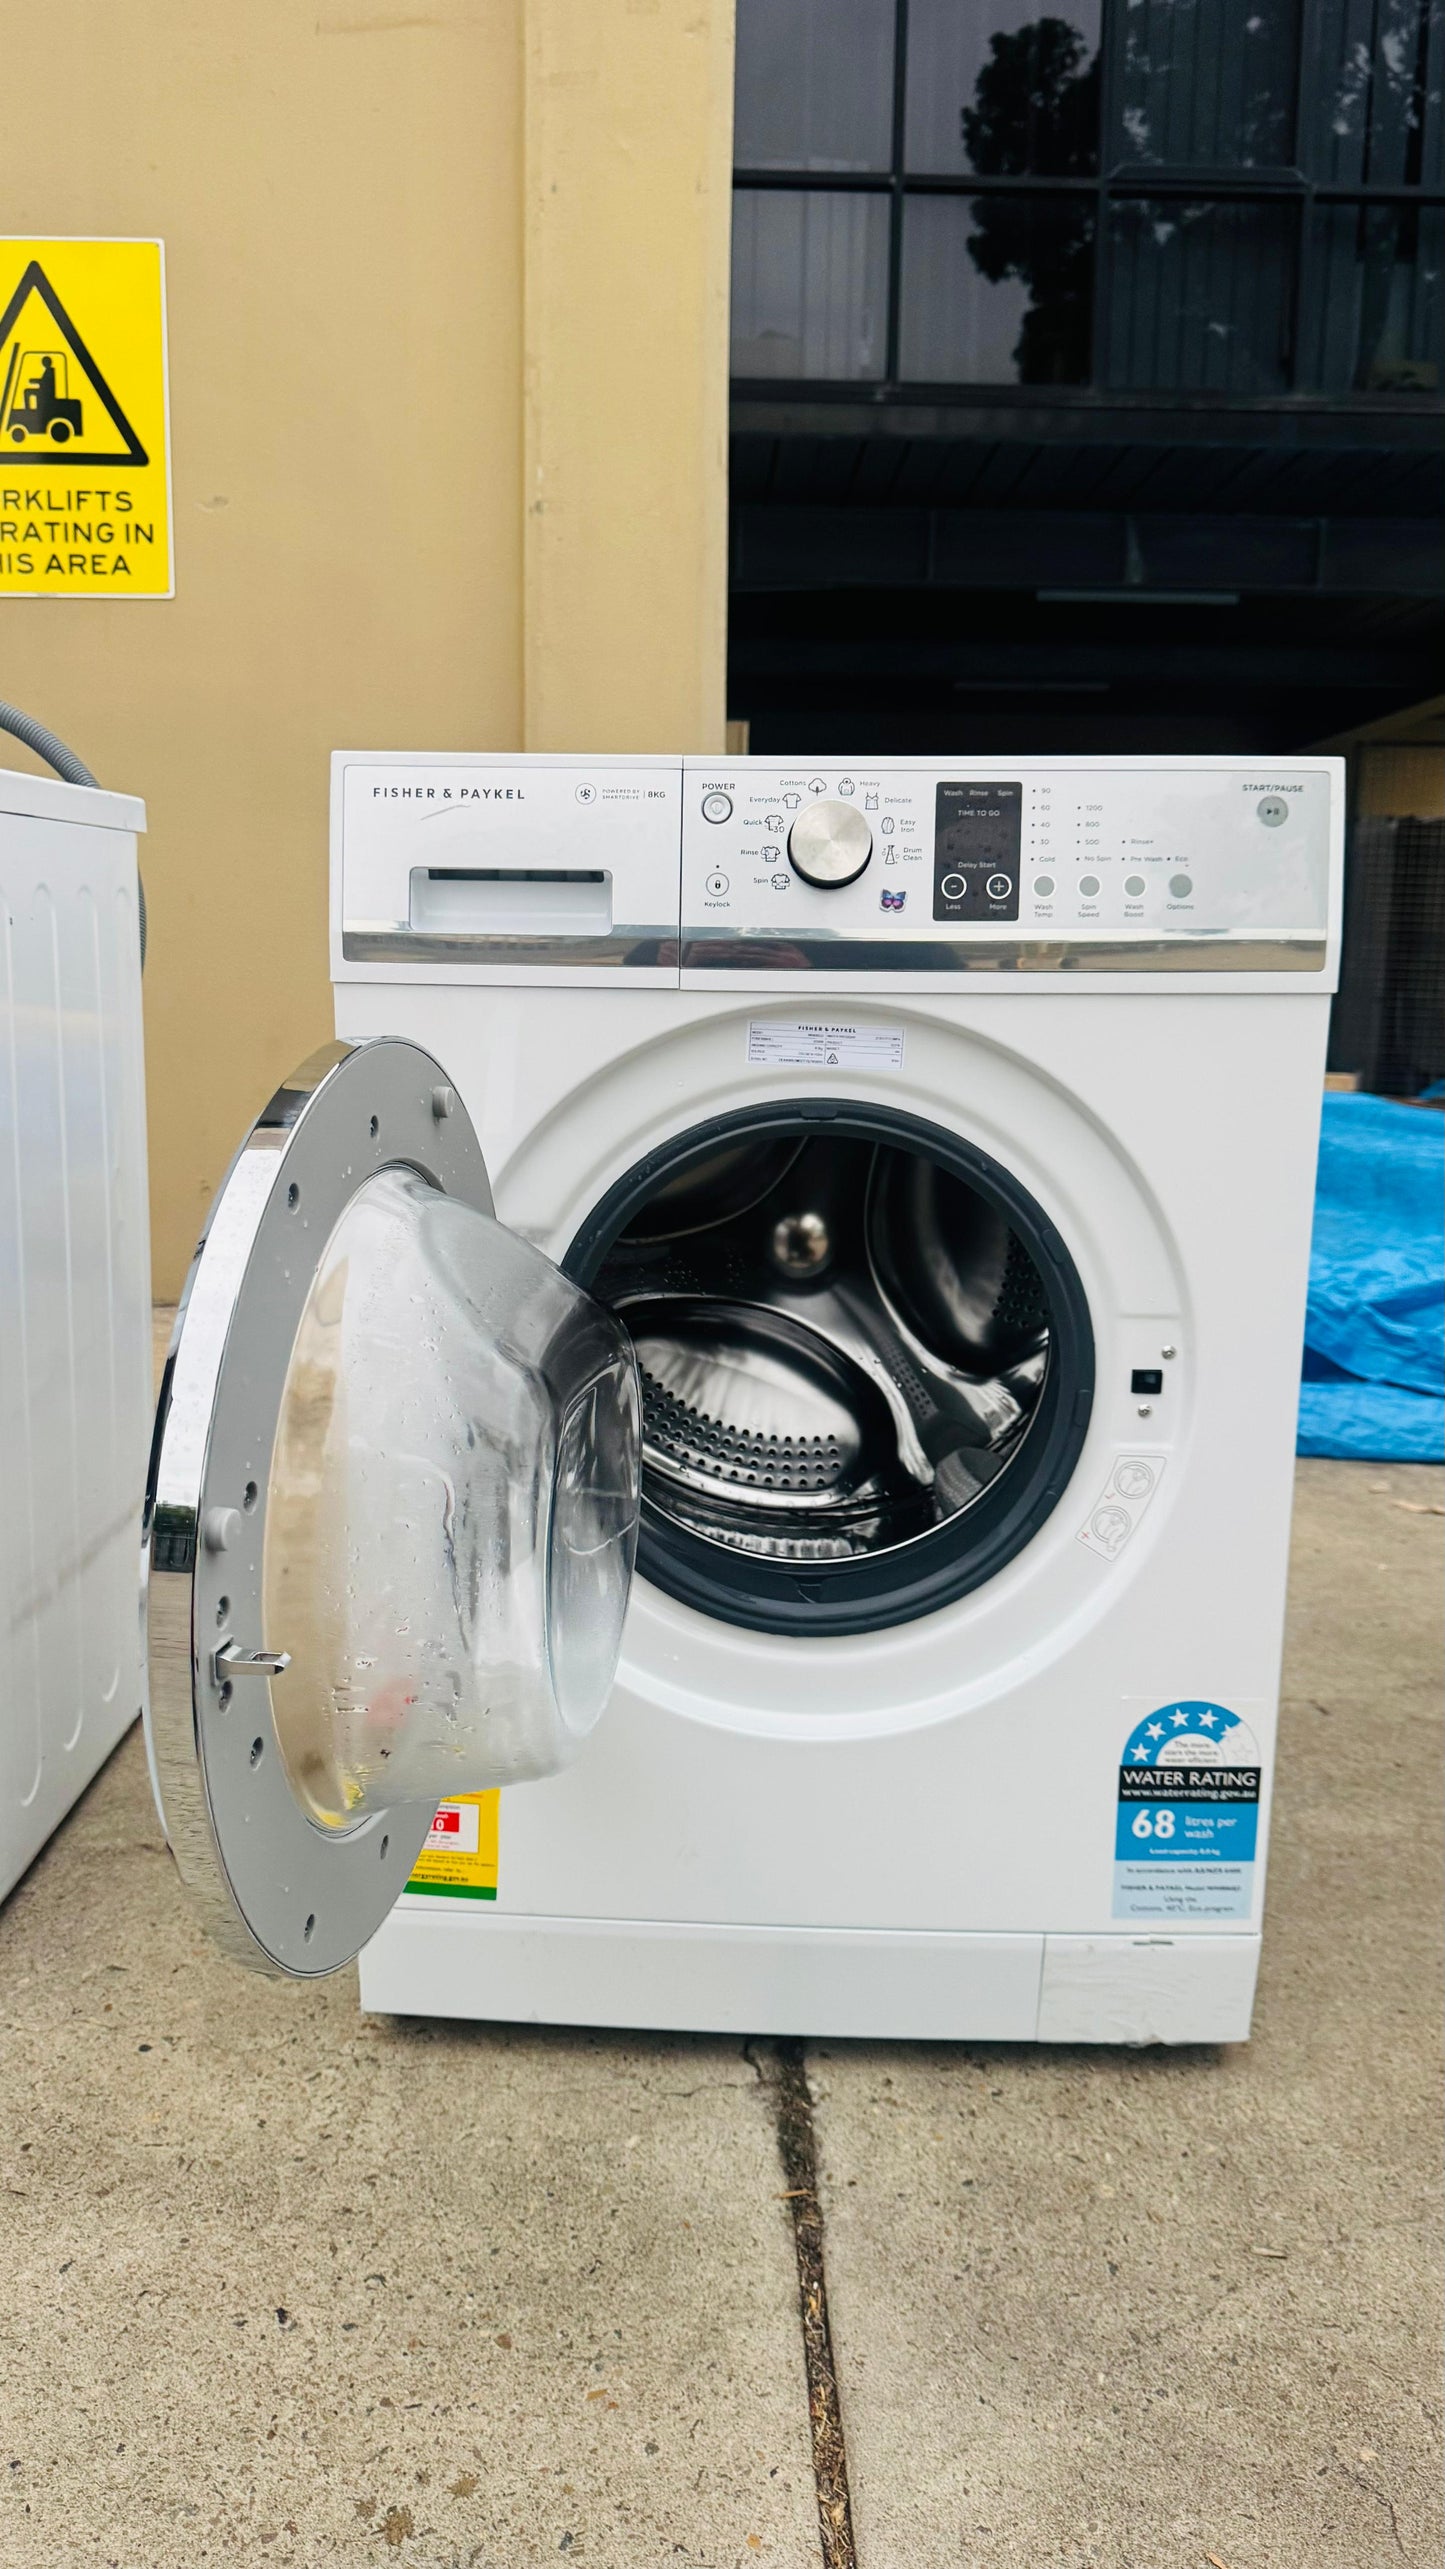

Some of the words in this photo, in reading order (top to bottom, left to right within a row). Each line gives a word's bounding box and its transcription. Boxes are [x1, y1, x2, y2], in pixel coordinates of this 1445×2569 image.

[126, 523, 154, 544] IN
[0, 553, 34, 575] IS
[45, 554, 131, 575] AREA
[779, 779, 807, 787] Cottons
[859, 780, 881, 788] Heavy
[1242, 784, 1304, 793] START/PAUSE
[373, 787, 436, 799] FISHER
[443, 788, 453, 799] &
[461, 788, 525, 800] PAYKEL
[648, 791, 666, 799] 8KG
[749, 796, 781, 804] Everyday
[884, 796, 913, 804] Delicate
[743, 818, 763, 826] Quick
[900, 819, 916, 827] Easy
[773, 825, 785, 833] 30
[1078, 911, 1100, 919] Speed
[1123, 1770, 1186, 1786] WATER
[1189, 1771, 1257, 1787] RATING
[1122, 1788, 1256, 1800] www.waterrating.gov.au
[1131, 1809, 1176, 1839] 68
[1185, 1816, 1215, 1827] litres
[1217, 1817, 1238, 1829] per
[1184, 1829, 1215, 1839] wash
